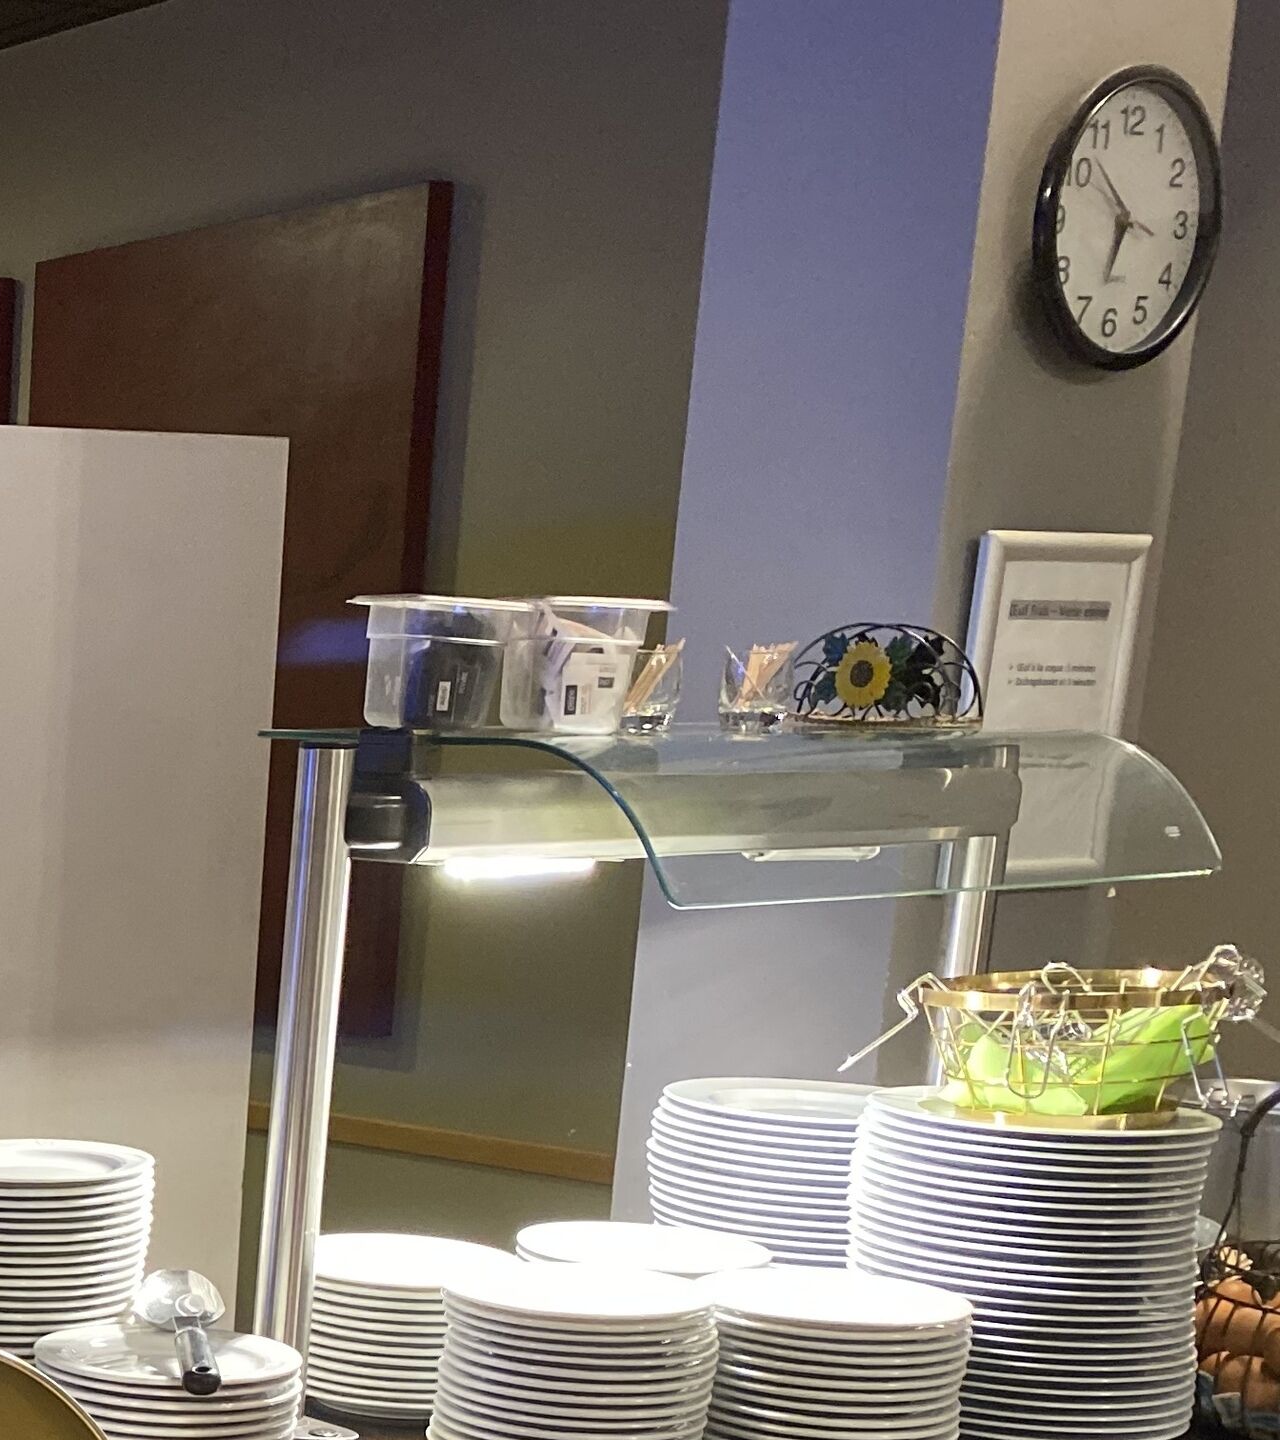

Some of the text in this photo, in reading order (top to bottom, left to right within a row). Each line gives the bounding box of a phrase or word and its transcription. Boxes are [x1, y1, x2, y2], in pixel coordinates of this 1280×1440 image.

[1089, 120, 1110, 149] 11
[1120, 105, 1146, 135] 12
[1155, 124, 1165, 153] 1
[1065, 158, 1092, 188] 10
[1169, 158, 1186, 188] 2
[1173, 210, 1188, 240] 3
[1158, 262, 1172, 291] 4
[1077, 296, 1093, 325] 7
[1102, 308, 1118, 337] 6
[1132, 296, 1149, 325] 5
